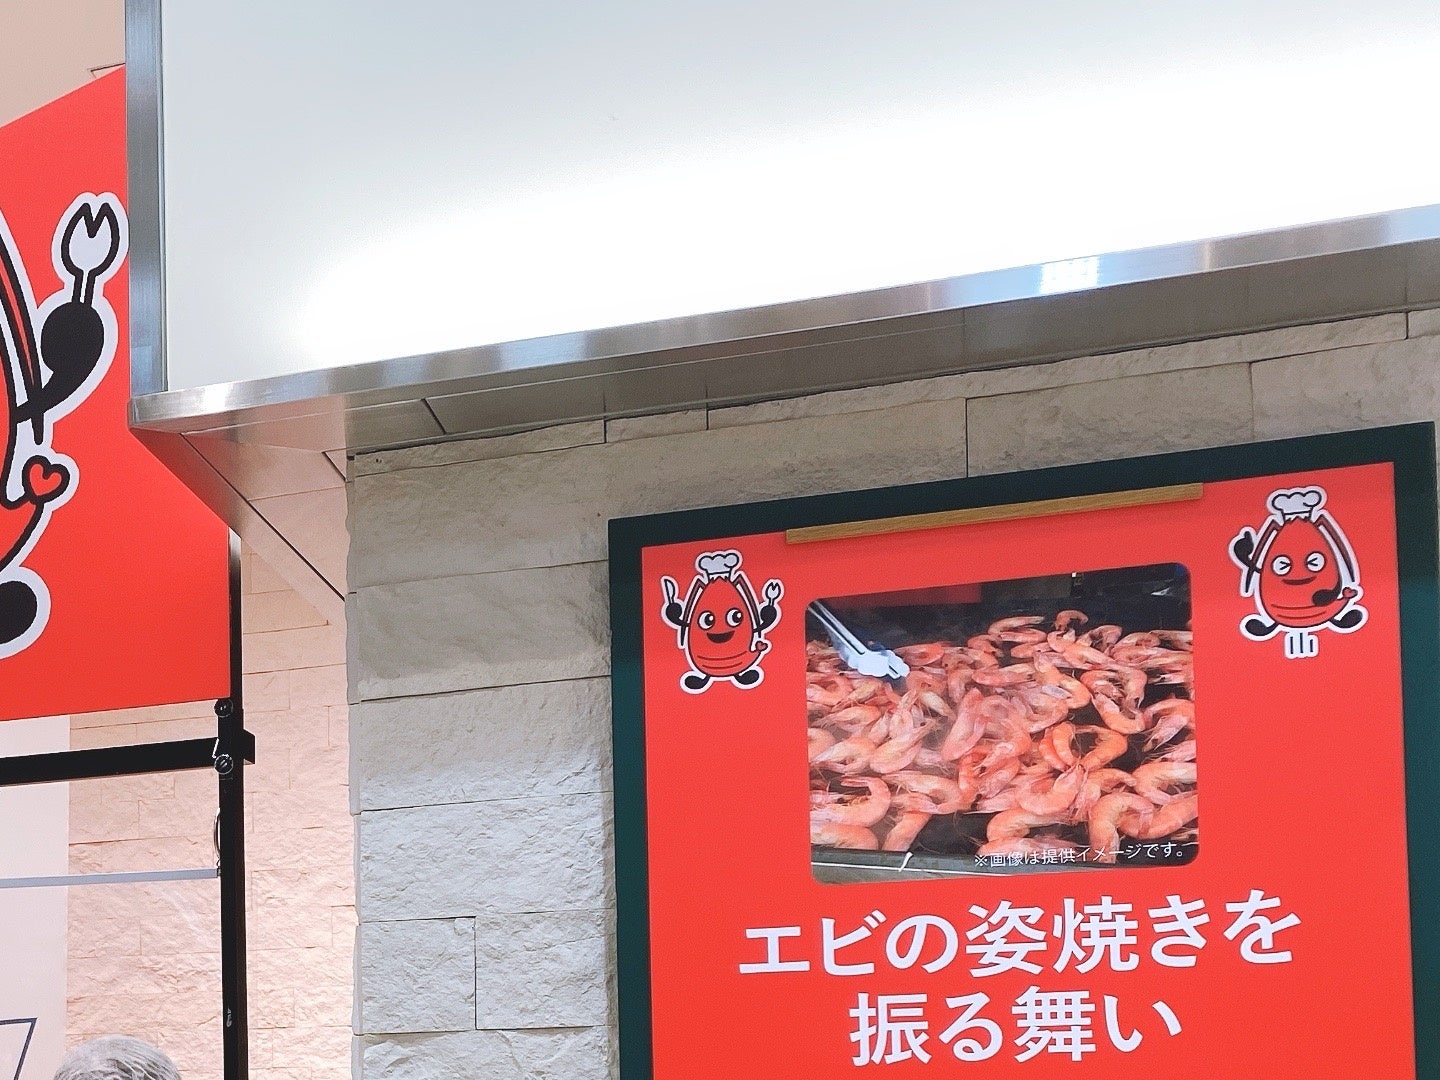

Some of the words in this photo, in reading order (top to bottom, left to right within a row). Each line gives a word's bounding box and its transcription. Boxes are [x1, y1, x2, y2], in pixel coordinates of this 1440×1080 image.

[974, 841, 1184, 868] ※画像は提供イメージです。
[739, 888, 1302, 978] エビの姿焼きを
[848, 985, 1183, 1067] 振る舞い
